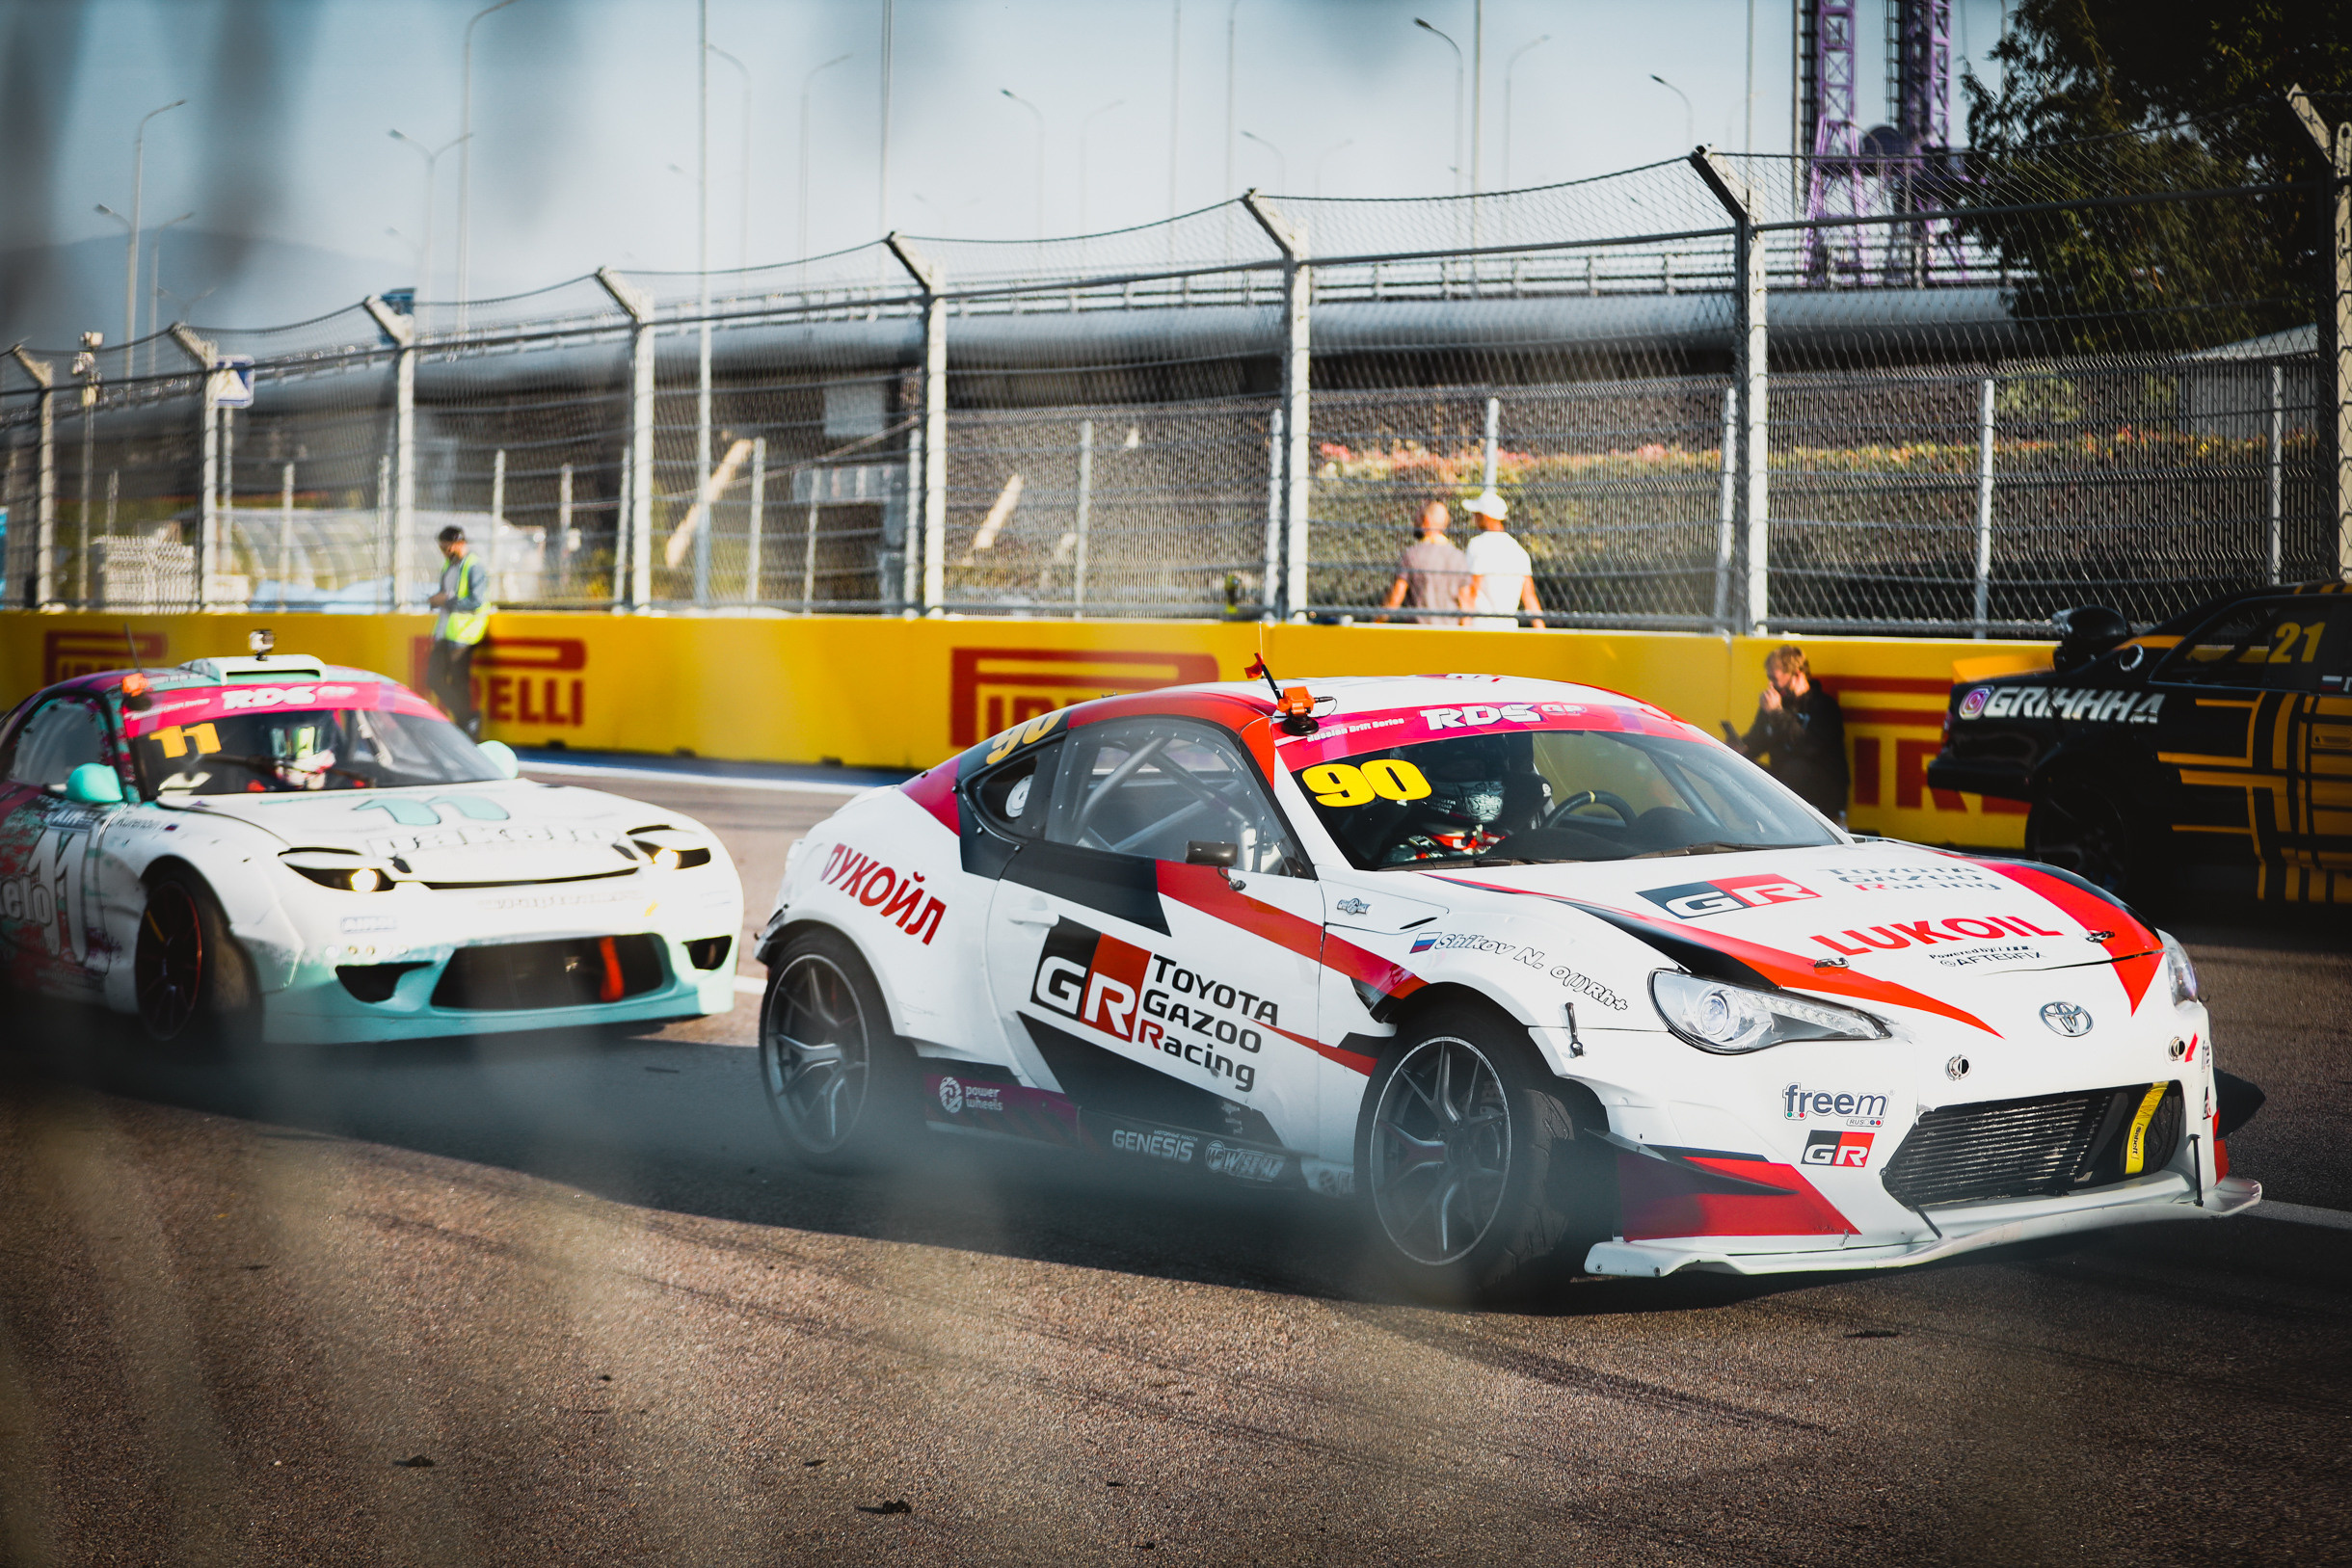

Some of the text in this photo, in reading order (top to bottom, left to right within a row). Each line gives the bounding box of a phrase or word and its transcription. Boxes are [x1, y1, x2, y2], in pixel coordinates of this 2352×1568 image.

[2268, 622, 2326, 663] 21
[409, 636, 587, 727] PELLI
[1419, 704, 1542, 731] RDS
[149, 723, 222, 758] 11
[1301, 758, 1432, 808] 90
[352, 795, 510, 825] 11
[820, 842, 947, 946] ЛУКОЙЛ
[1666, 882, 1819, 917] GR
[1434, 933, 1515, 955] Shikov
[1513, 946, 1544, 970] N.
[1809, 916, 2064, 956] LUKOIL
[1036, 955, 1136, 1038] GR
[1153, 953, 1279, 1027] TOYOTA
[1142, 989, 1262, 1054] GAZOO
[1137, 1019, 1256, 1093] Racing
[965, 1086, 1001, 1098] power
[965, 1097, 1003, 1111] wheels
[1785, 1084, 1887, 1116] freem
[1112, 1129, 1194, 1162] GENESIS
[1804, 1144, 1869, 1166] GR
